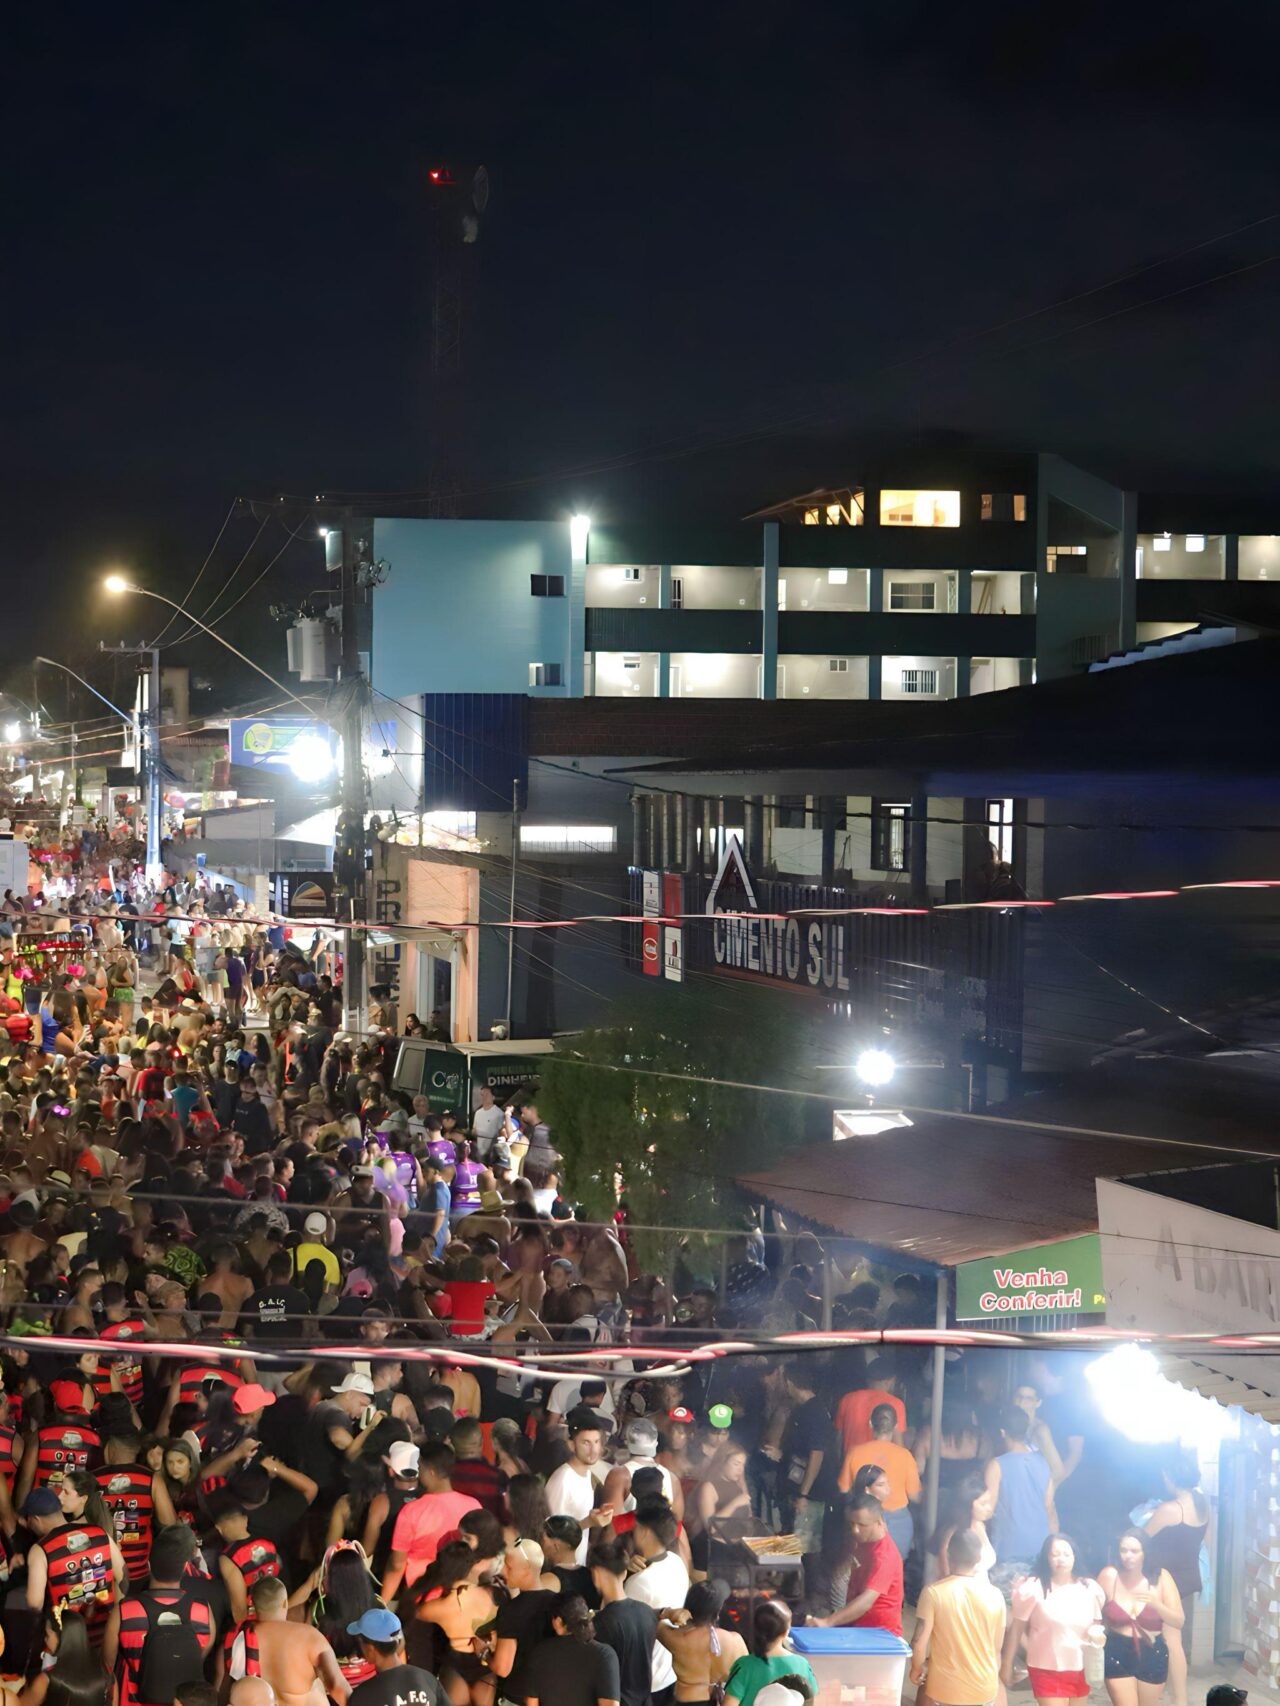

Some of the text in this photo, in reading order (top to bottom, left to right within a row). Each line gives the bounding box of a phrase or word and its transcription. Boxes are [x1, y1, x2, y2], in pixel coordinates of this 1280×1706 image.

[714, 906, 850, 991] CIMENTO SUL
[994, 1267, 1068, 1288] Venha
[980, 1288, 1081, 1312] Conferir!
